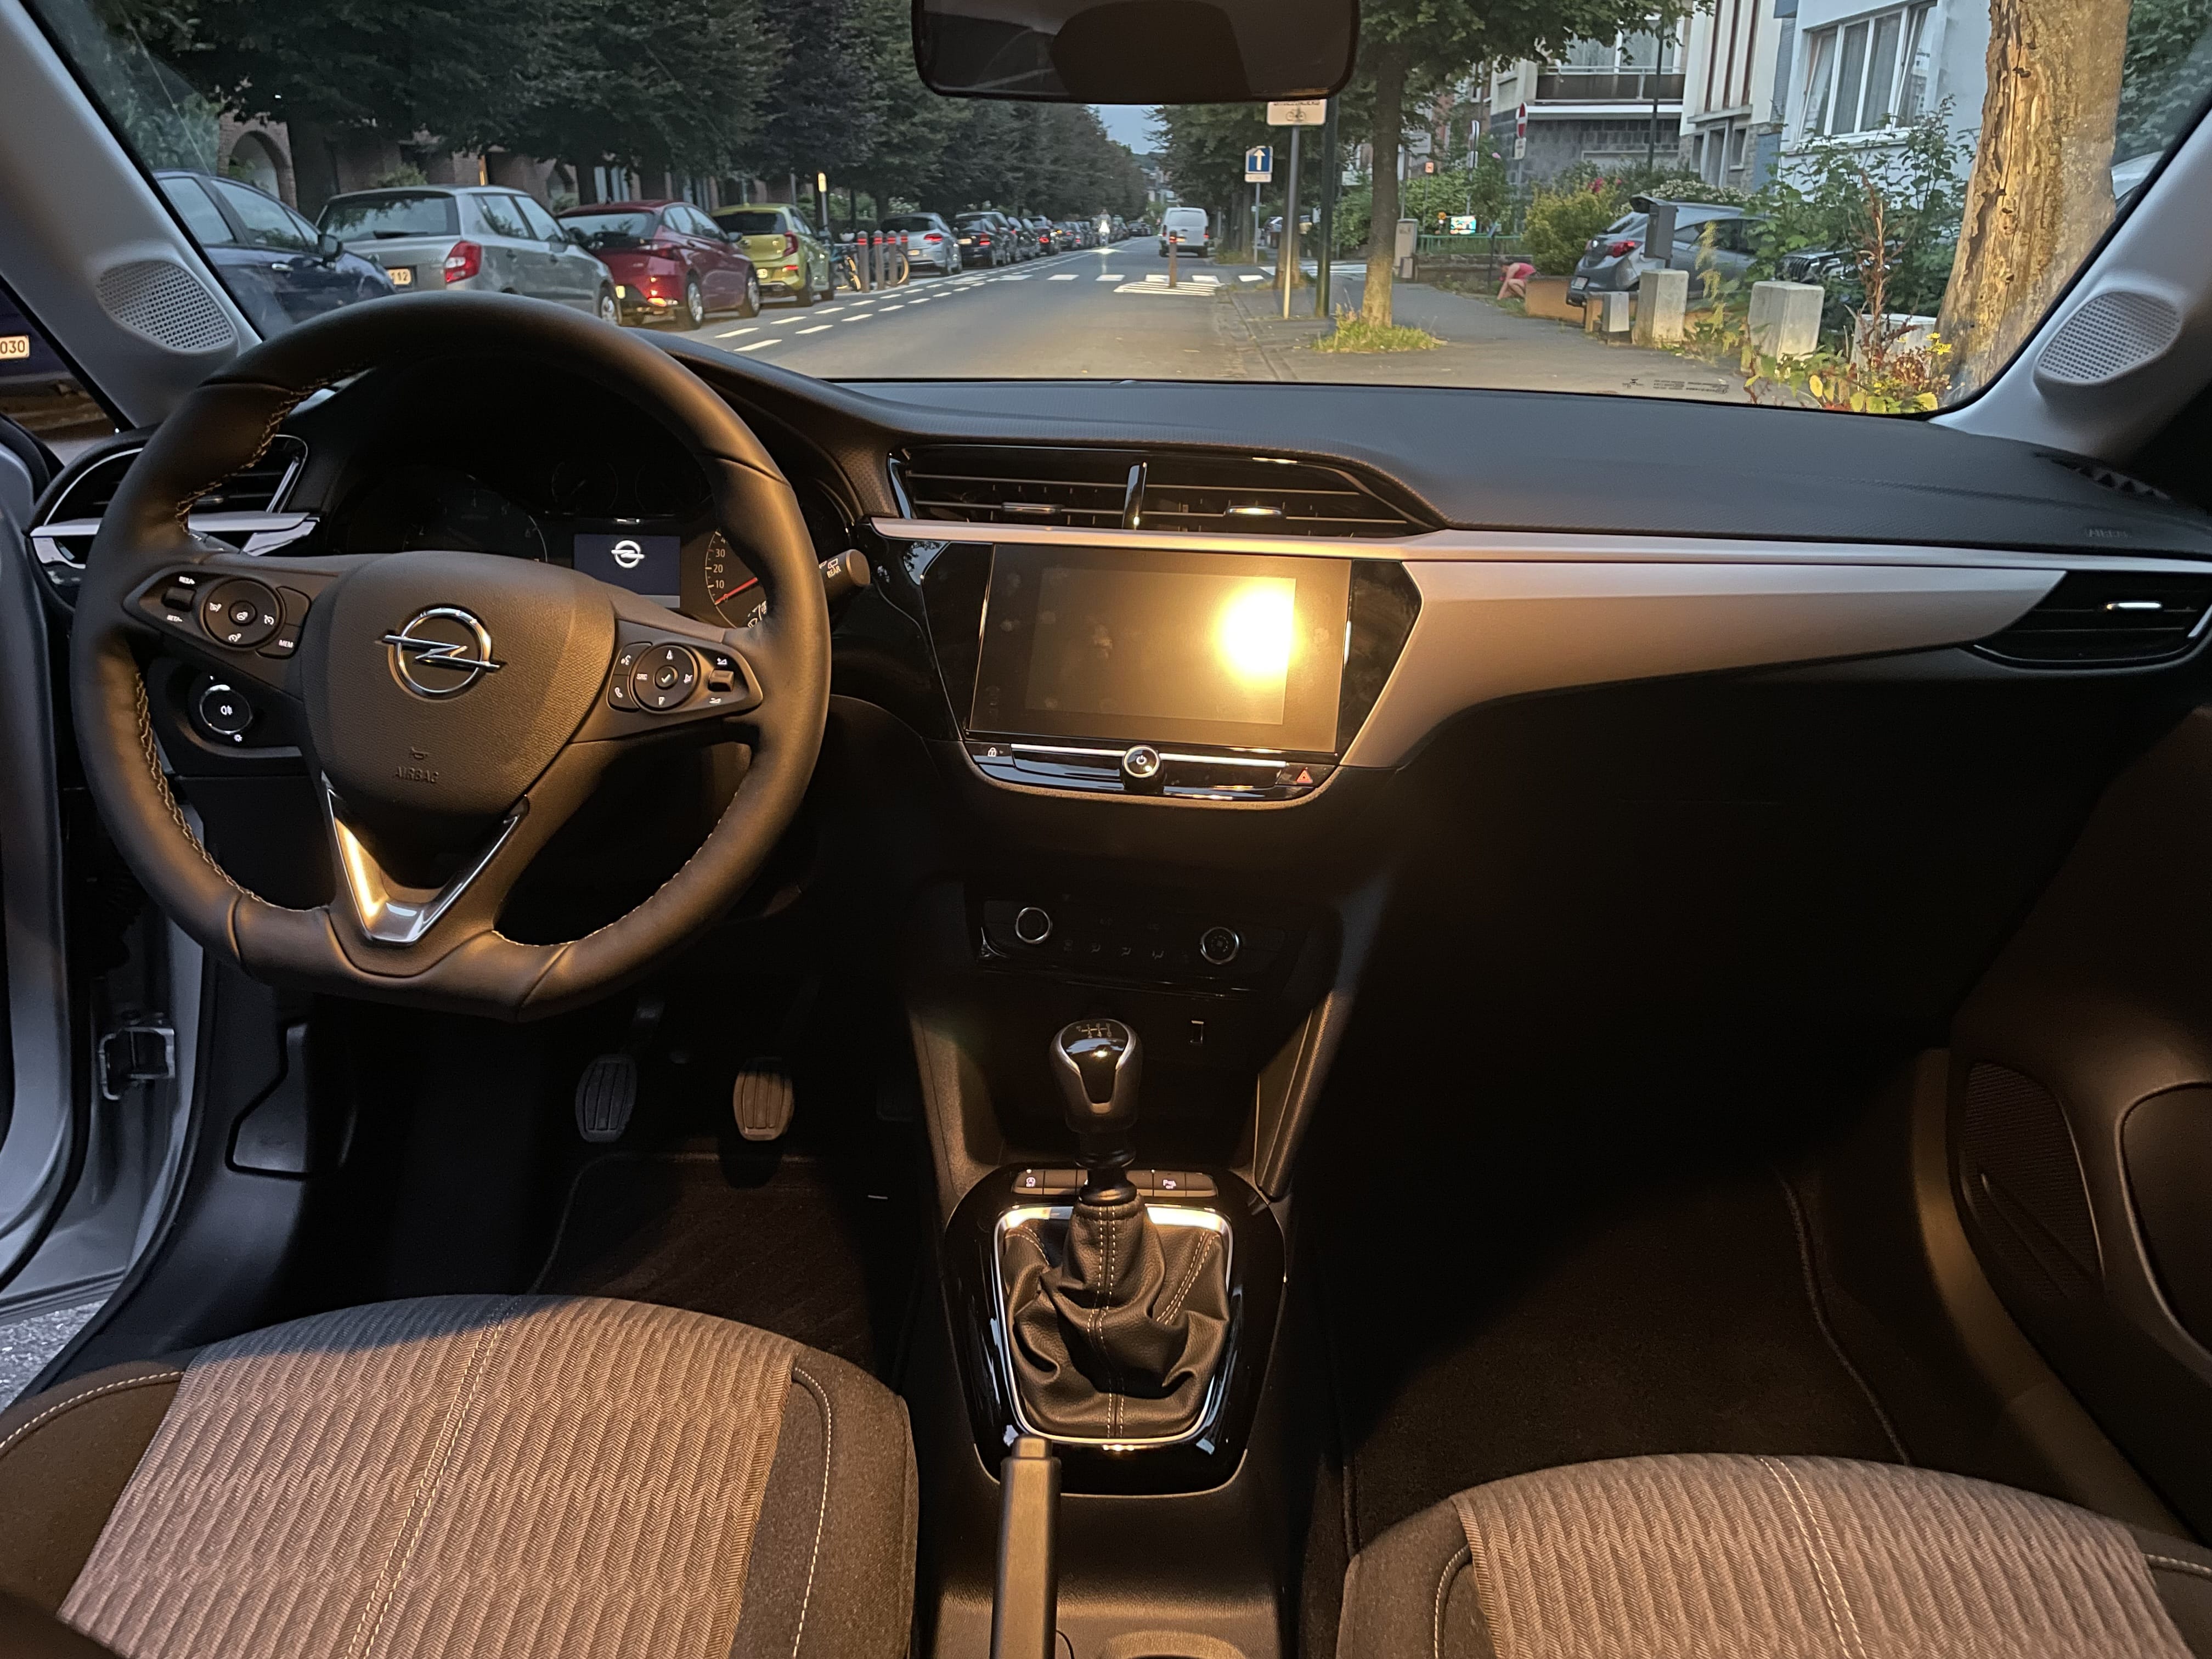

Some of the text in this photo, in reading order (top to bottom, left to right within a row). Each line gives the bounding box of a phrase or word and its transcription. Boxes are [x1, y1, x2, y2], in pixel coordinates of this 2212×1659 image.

[1, 340, 25, 354] 030
[715, 548, 725, 557] 30
[713, 563, 723, 573] 20
[826, 565, 842, 579] REAR
[715, 579, 724, 589] 10
[278, 639, 294, 649] MEM
